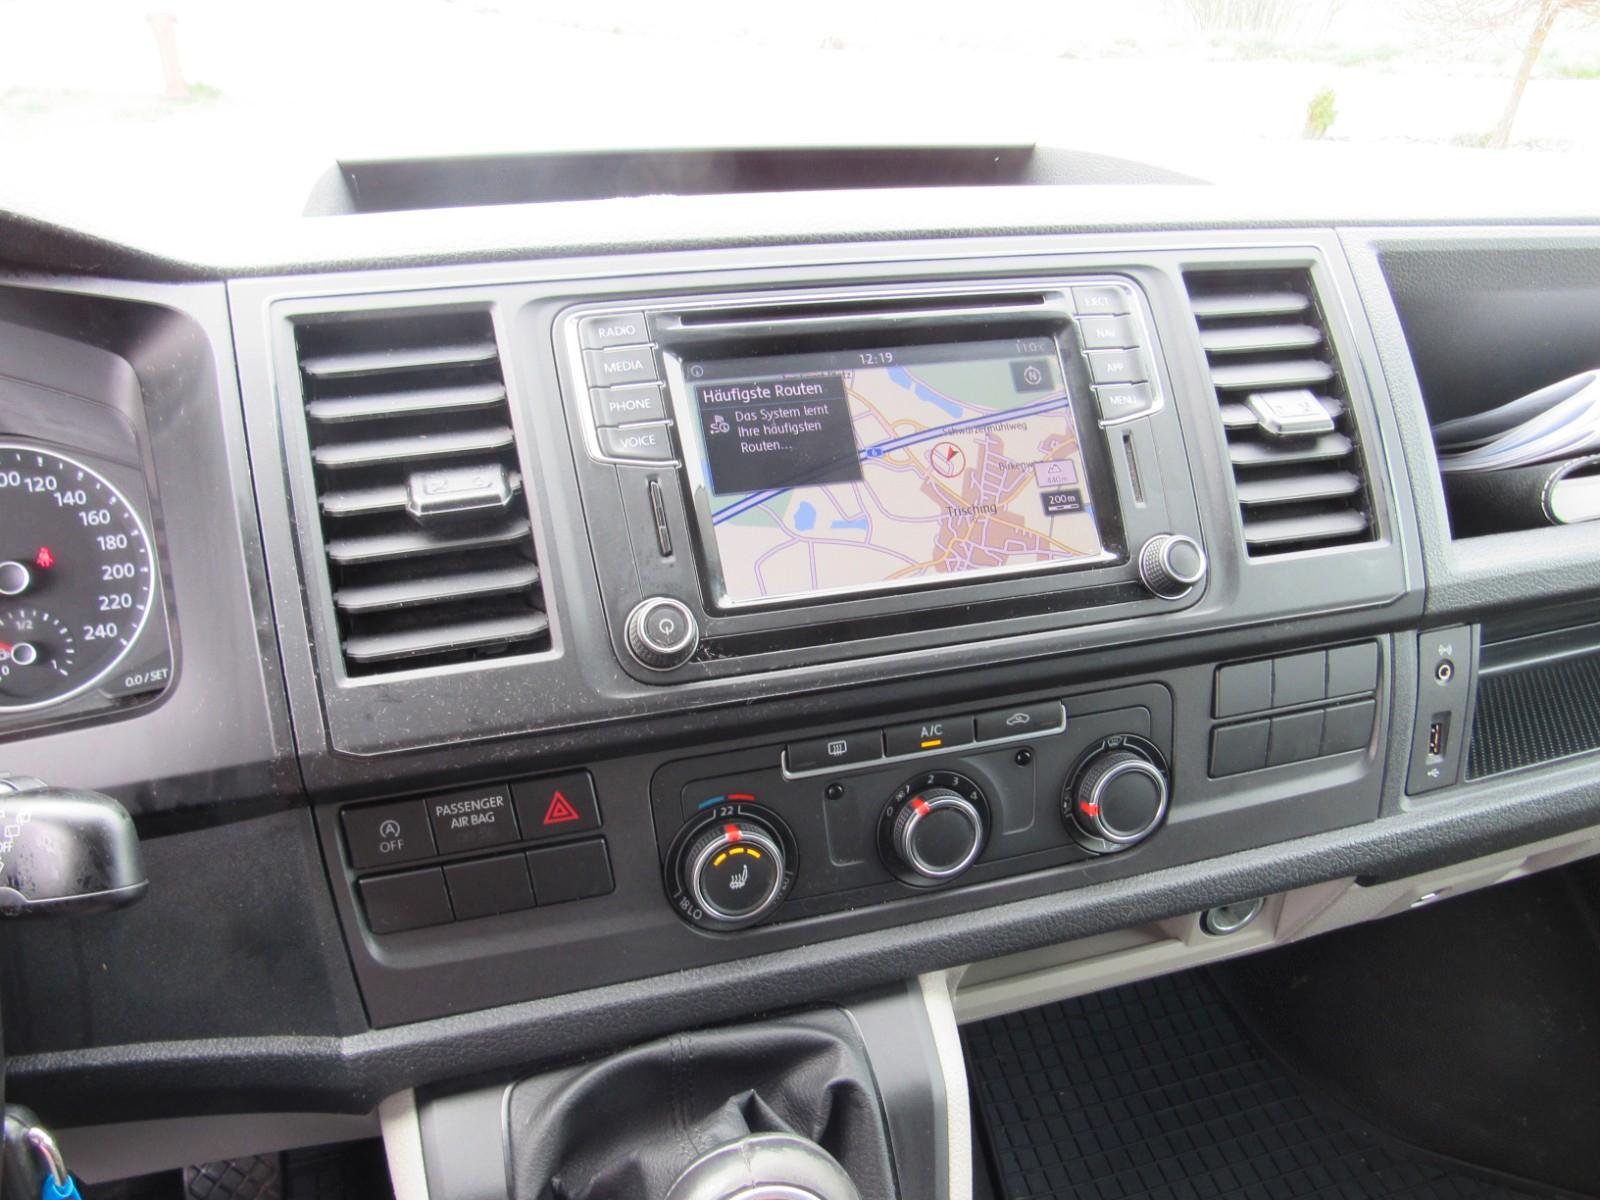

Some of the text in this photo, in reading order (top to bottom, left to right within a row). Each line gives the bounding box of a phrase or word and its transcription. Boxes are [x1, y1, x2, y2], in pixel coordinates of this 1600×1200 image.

[598, 325, 636, 338] RADIO
[859, 351, 894, 365] 12:19
[603, 359, 644, 374] MEDIA
[703, 382, 823, 404] Häufigste Routen
[609, 397, 652, 413] PHONE
[735, 403, 830, 424] Das System lernt
[737, 420, 822, 438] Ihre häufigsten
[619, 434, 657, 448] VOICE
[741, 440, 793, 454] Routen...
[24, 475, 58, 493] 120
[54, 489, 87, 507] 140
[79, 509, 111, 527] 160
[945, 501, 998, 522] Trisching
[97, 533, 128, 551] 180
[102, 563, 135, 581] 200
[99, 593, 133, 611] 220
[83, 622, 118, 641] 240
[1, 664, 9, 676] 0
[920, 723, 943, 739] A/C
[927, 774, 935, 784] 2
[952, 776, 959, 786] 3
[905, 784, 911, 794] 1
[970, 791, 978, 800] 4
[435, 796, 505, 817] PASSENGER
[720, 806, 735, 817] 22
[886, 806, 894, 817] 0
[450, 812, 496, 831] AIR BAG
[379, 838, 405, 854] OFF
